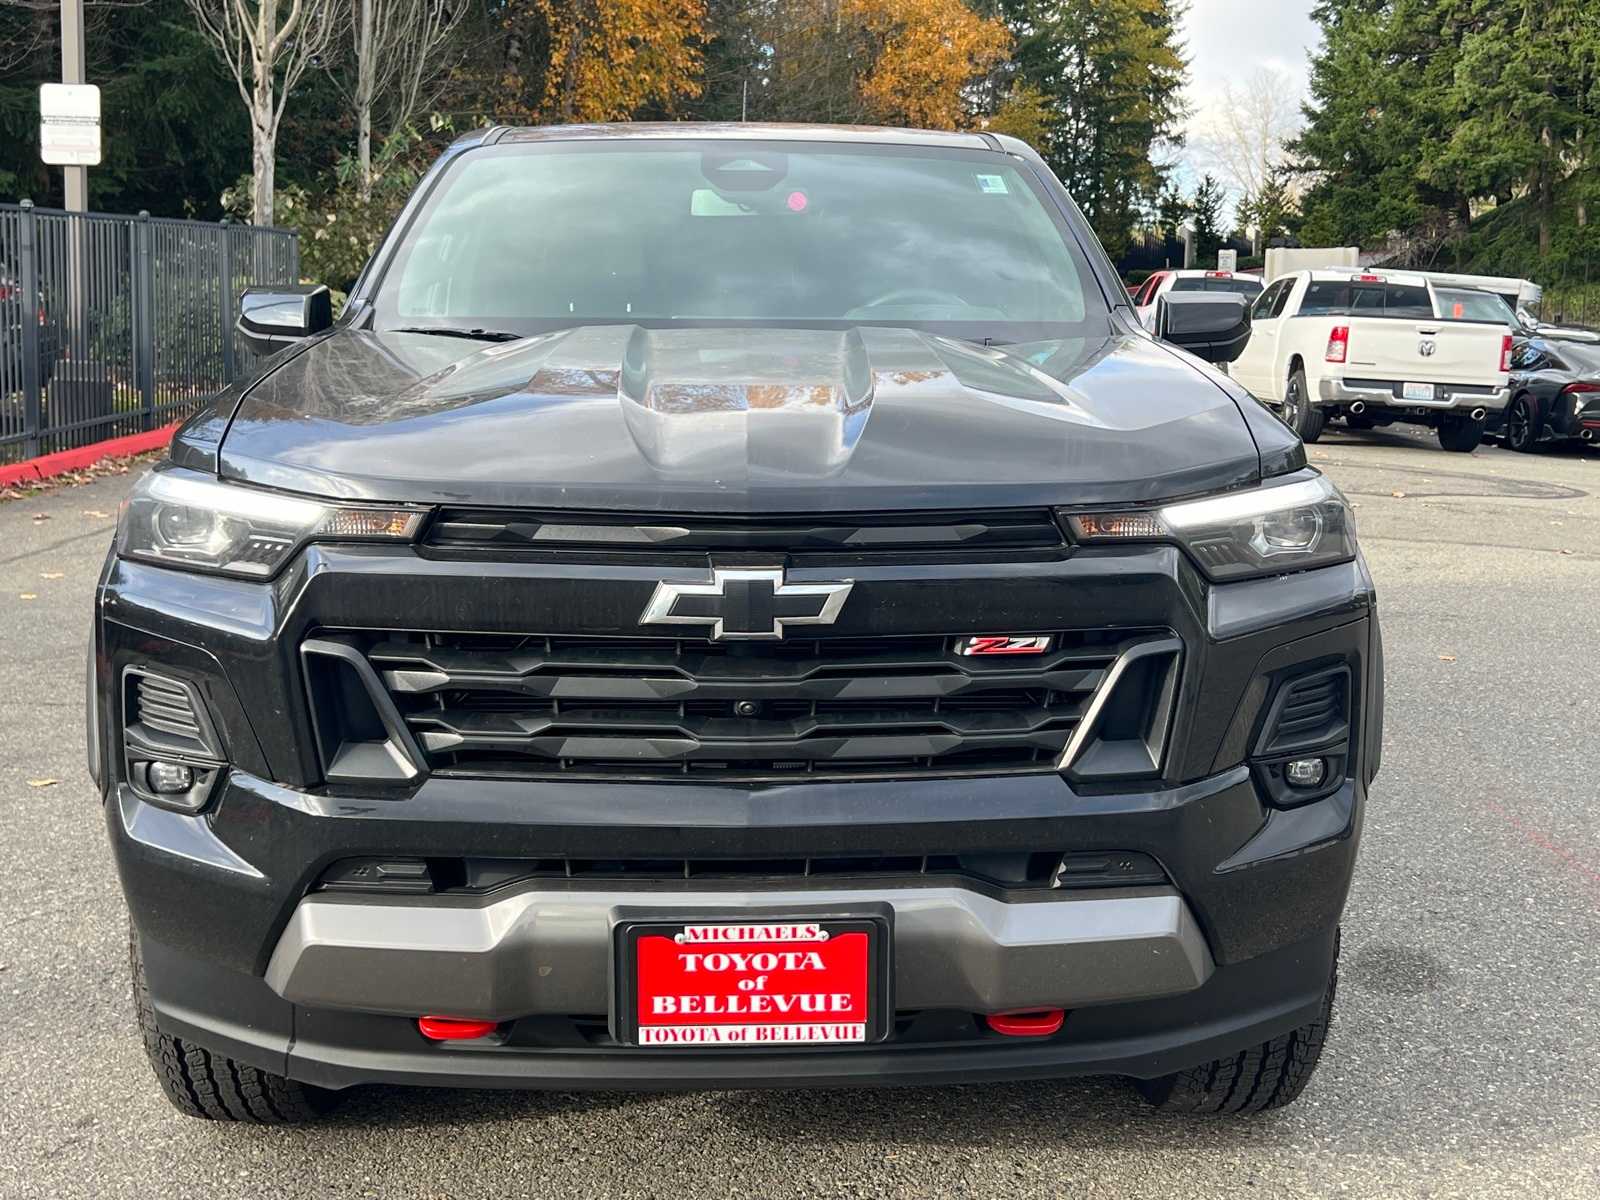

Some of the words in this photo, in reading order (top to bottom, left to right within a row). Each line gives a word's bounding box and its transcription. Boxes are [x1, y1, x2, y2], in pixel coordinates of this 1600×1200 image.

[963, 636, 1050, 655] Z71
[687, 925, 817, 941] MICHAELS
[678, 952, 826, 972] TOYOTA
[737, 975, 769, 991] of
[652, 993, 852, 1014] BELLEVUE
[641, 1026, 721, 1043] TOYOTA
[728, 1026, 749, 1042] of
[756, 1024, 863, 1042] BELLEVUE
